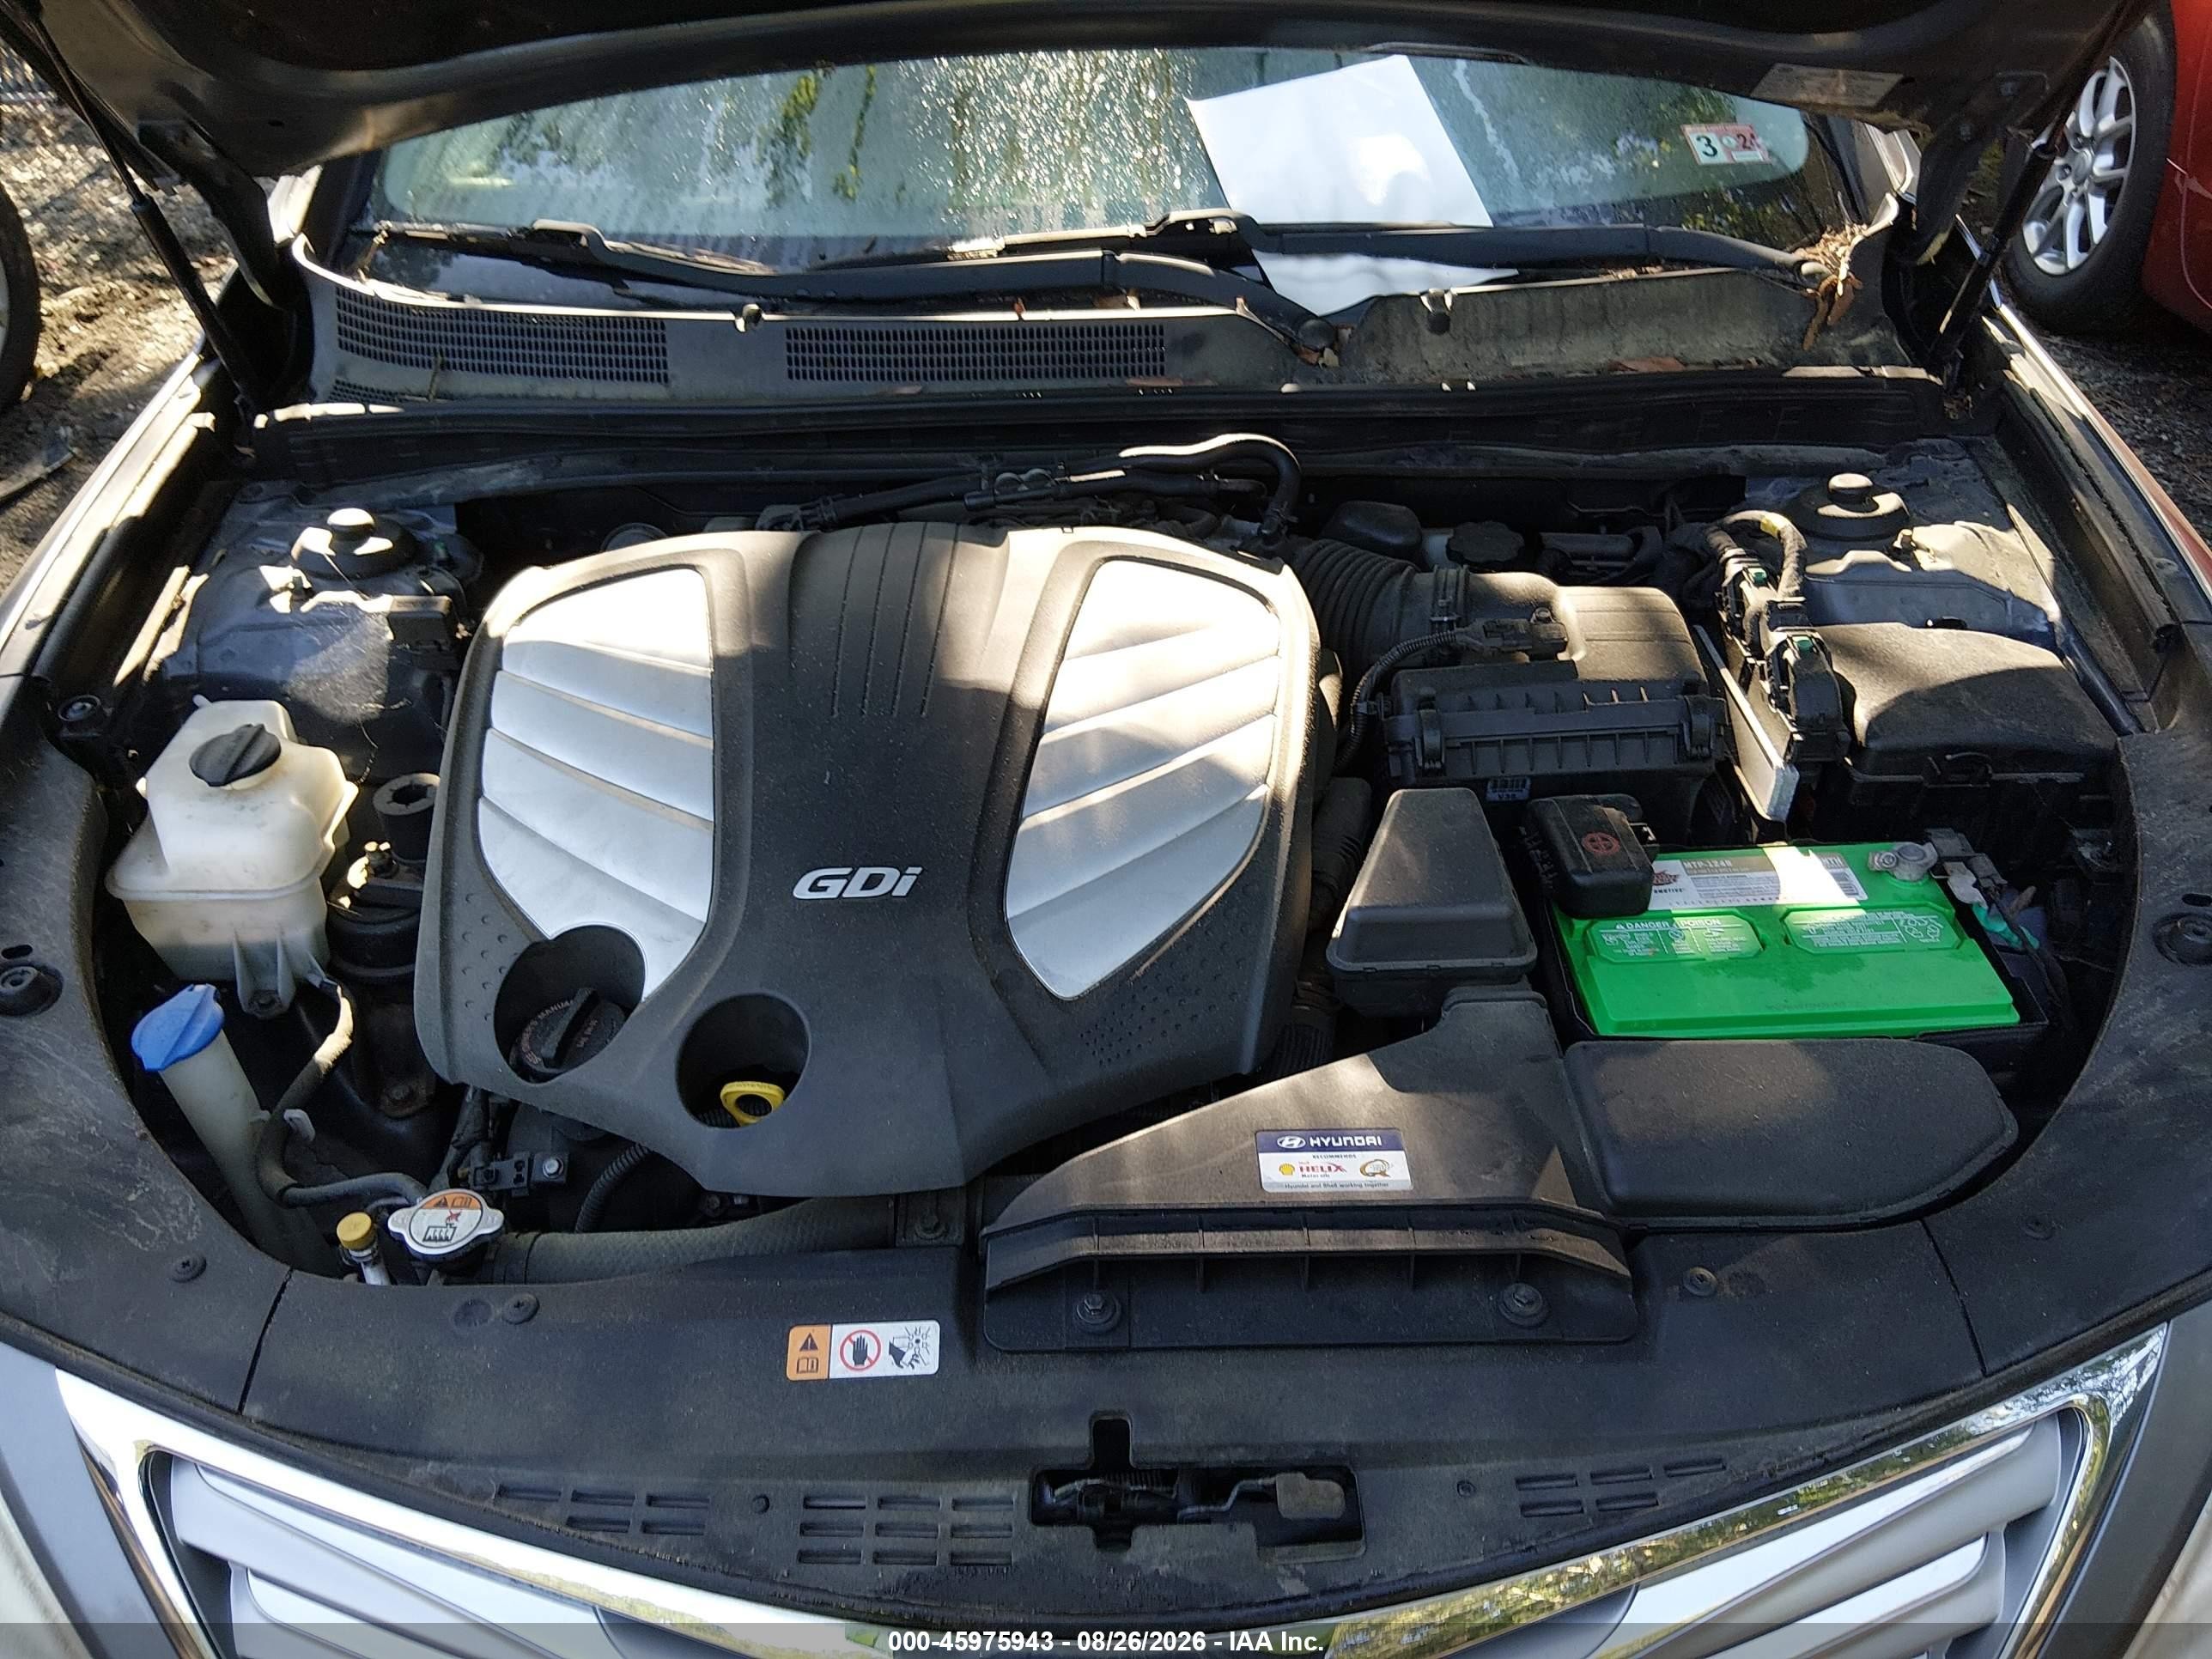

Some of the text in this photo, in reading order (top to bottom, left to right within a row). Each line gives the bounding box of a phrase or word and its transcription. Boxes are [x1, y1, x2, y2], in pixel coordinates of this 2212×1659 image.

[1696, 135, 1718, 157] 3
[793, 866, 923, 899] GDi
[1680, 919, 1722, 927] POISON
[1310, 1136, 1382, 1147] HYUNDAI
[1299, 1164, 1345, 1174] HELIX
